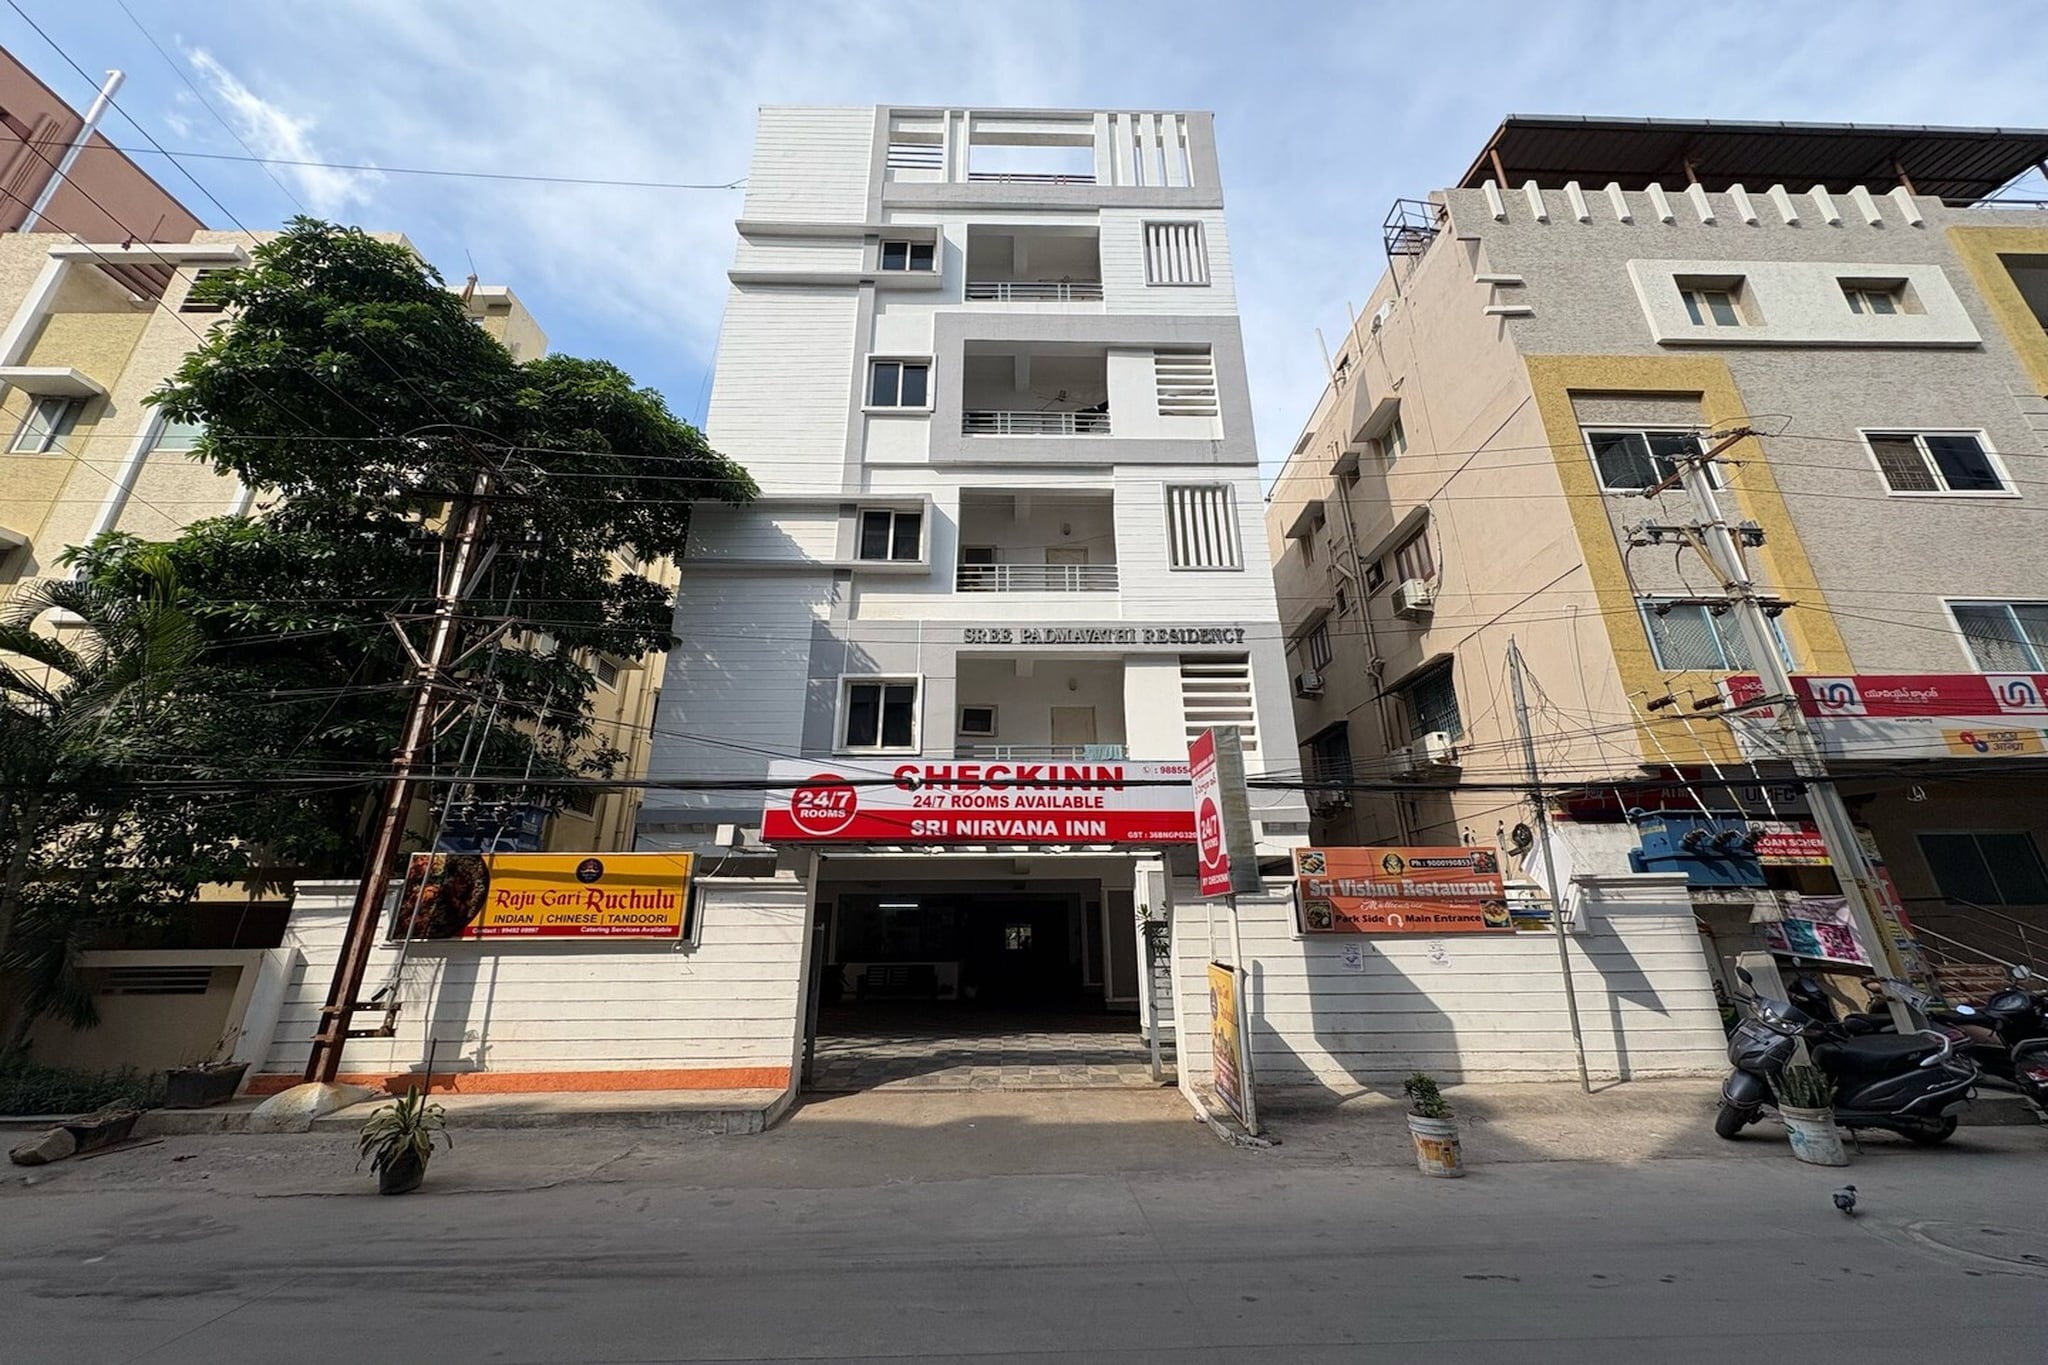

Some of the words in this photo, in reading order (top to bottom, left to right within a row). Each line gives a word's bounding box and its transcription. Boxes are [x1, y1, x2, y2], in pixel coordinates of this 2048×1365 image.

[964, 628, 1013, 644] SREE
[1020, 628, 1137, 644] PADMAVATHI
[1142, 628, 1245, 644] RESIDENCY
[894, 765, 1124, 791] CHECKINN
[798, 791, 852, 808] 24/7
[913, 795, 945, 808] 24/7
[951, 795, 1009, 808] ROOMS
[1015, 795, 1104, 808] AVAILABLE
[800, 809, 846, 818] ROOMS
[911, 819, 948, 836] SRI
[957, 820, 1058, 836] NIRVANA
[1066, 820, 1106, 836] INN
[1127, 831, 1143, 839] GST
[1309, 879, 1335, 896] Sri
[1339, 878, 1399, 896] Vishnu
[1402, 879, 1498, 896] Restaurant
[496, 888, 535, 911] Raju
[541, 889, 581, 907] Gari
[584, 887, 675, 913] Ruchulu
[494, 914, 534, 923] INDIAN
[546, 914, 597, 923] CHINESE
[608, 914, 668, 923] TANDOORI
[1335, 914, 1360, 923] Park
[1361, 914, 1385, 923] Side
[1405, 914, 1432, 923] Main
[1433, 914, 1482, 923] Entrance
[580, 926, 610, 934] Catering
